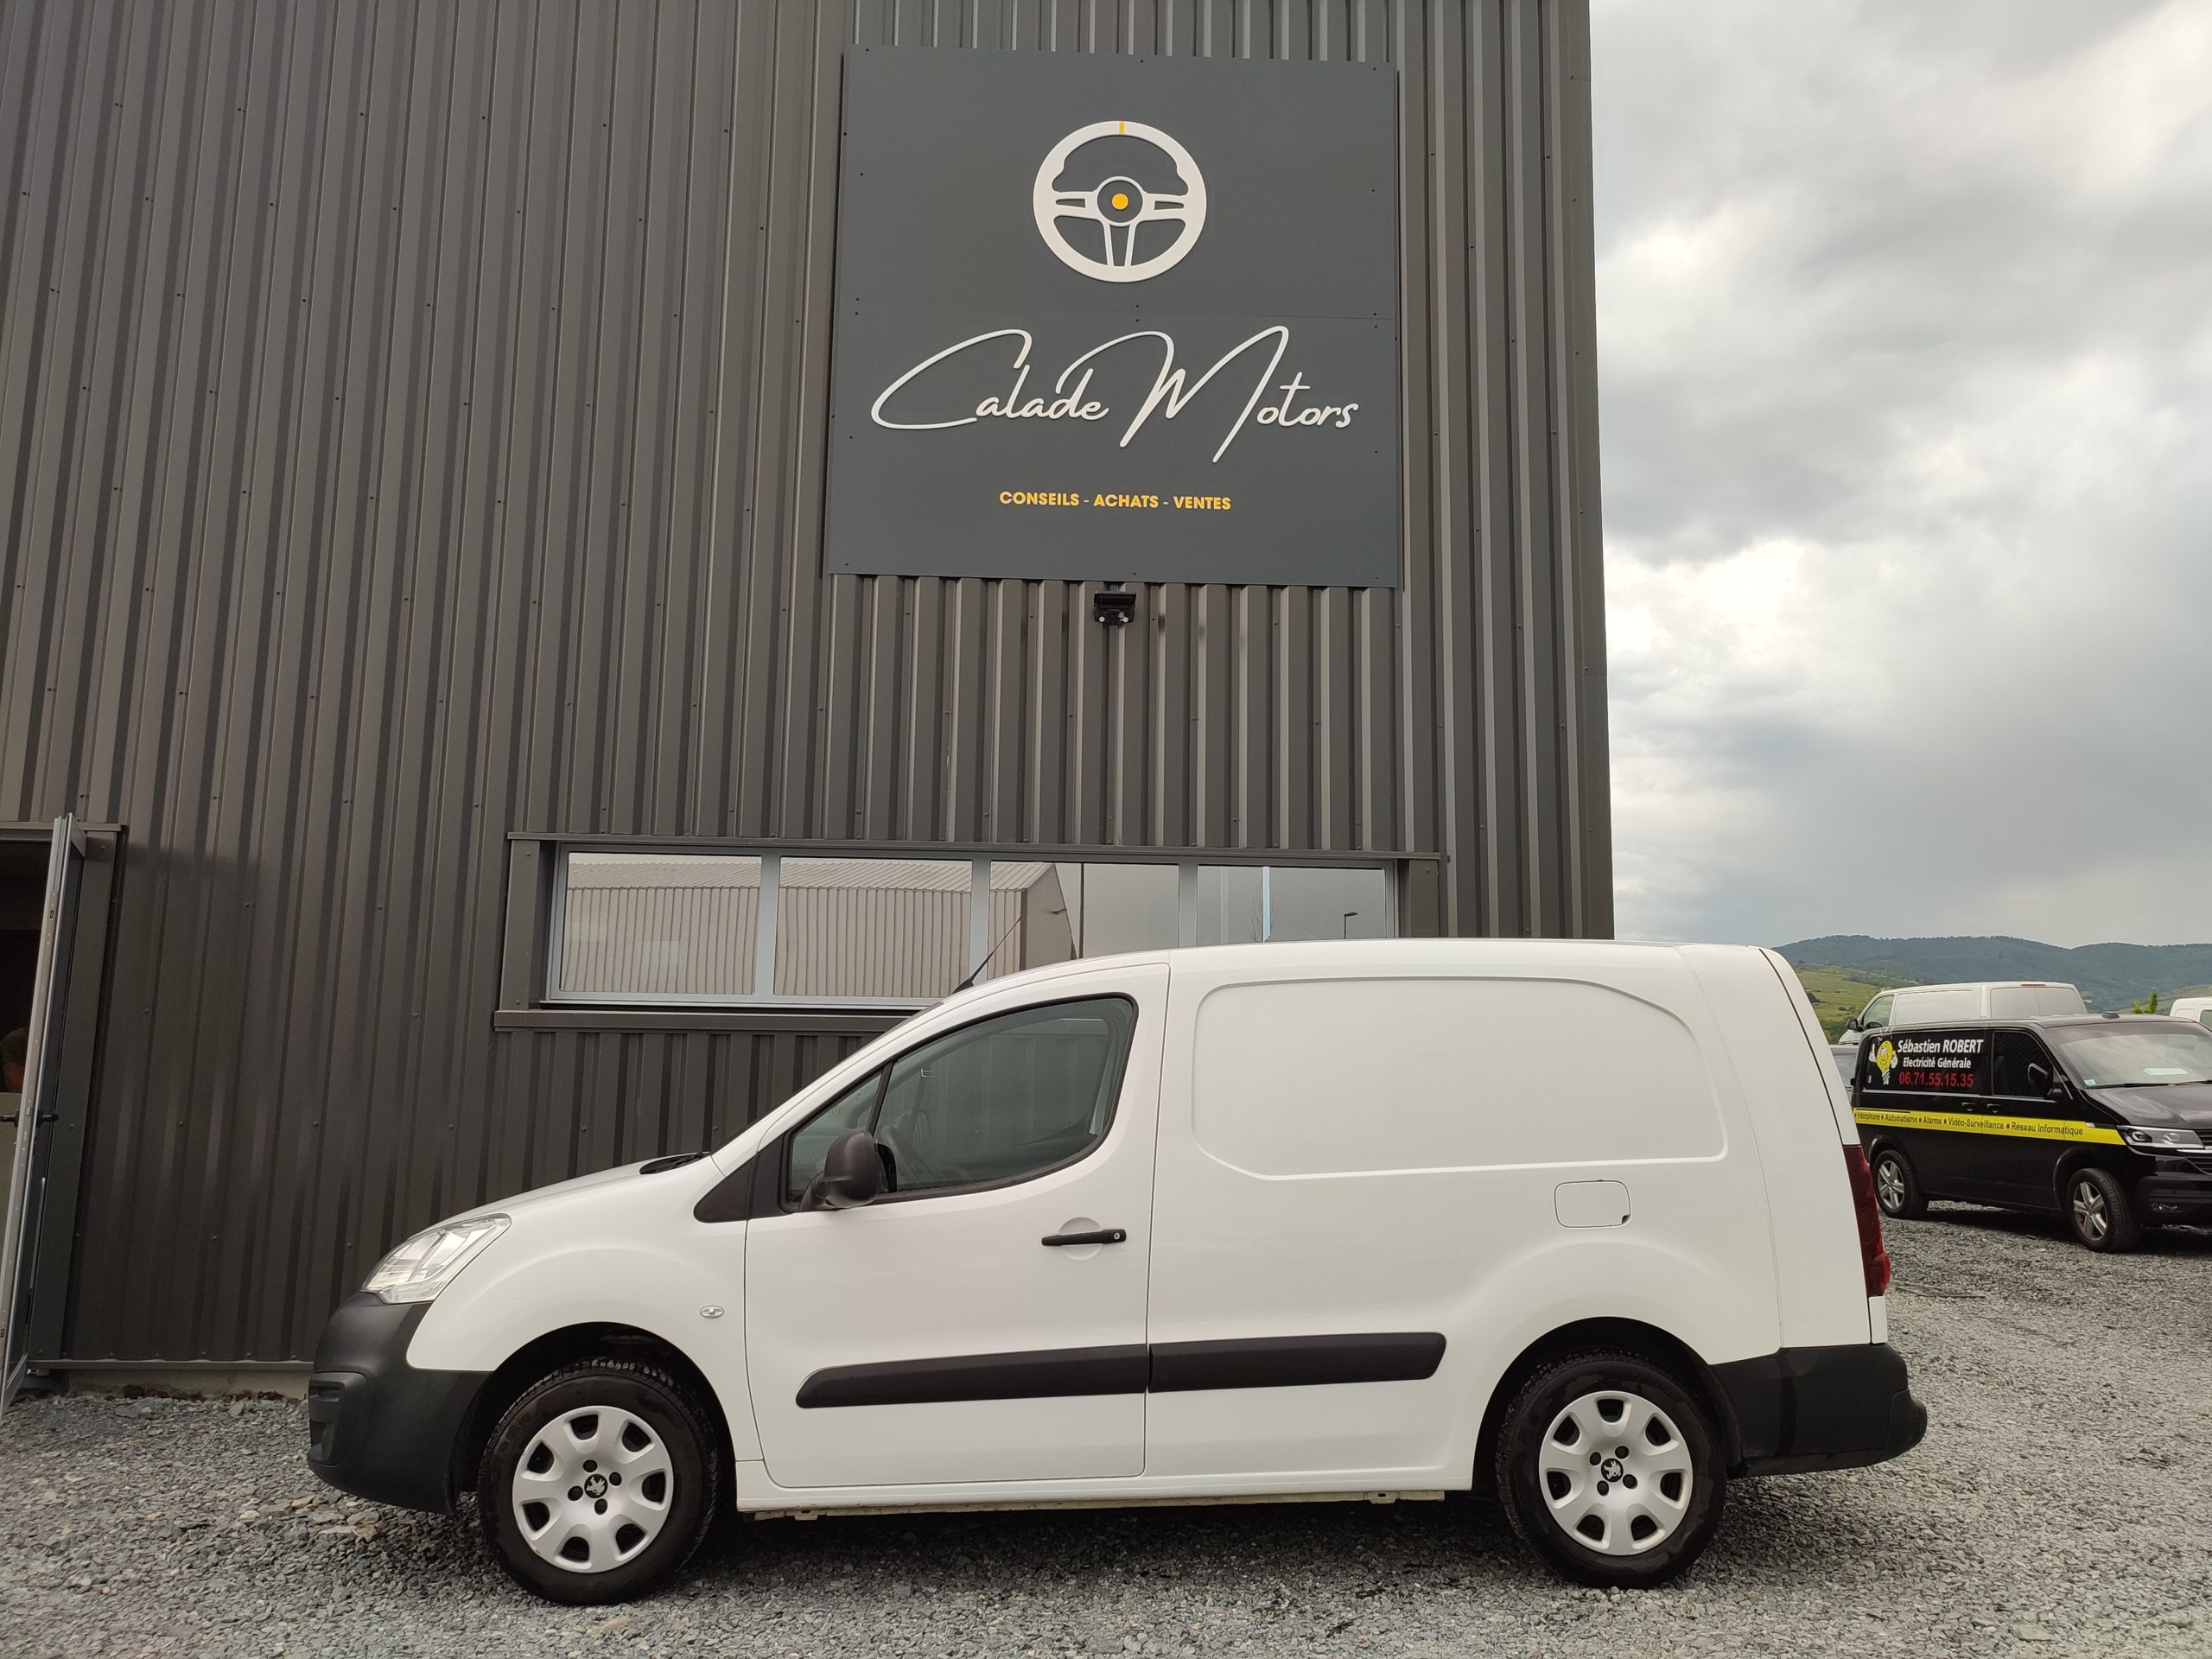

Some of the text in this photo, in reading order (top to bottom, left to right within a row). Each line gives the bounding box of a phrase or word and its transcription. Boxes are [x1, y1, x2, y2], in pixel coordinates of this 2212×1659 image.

[871, 326, 1359, 463] Calade Motors
[999, 491, 1079, 506] CONSEILS
[1093, 493, 1159, 508] ACHATS
[1173, 496, 1231, 511] VENTES
[1897, 1039, 1984, 1053] Sébastien ROBERT
[1903, 1057, 1971, 1069] Electricité Générale
[1899, 1071, 1974, 1087] 06.71.55.15.35
[1885, 1114, 1917, 1123] Automatisme
[1923, 1116, 1942, 1125] Alarme
[1948, 1117, 2004, 1129] Vidéo-Surveillance
[2011, 1122, 2036, 1132] Réseau
[2037, 1124, 2083, 1136] Informatique
